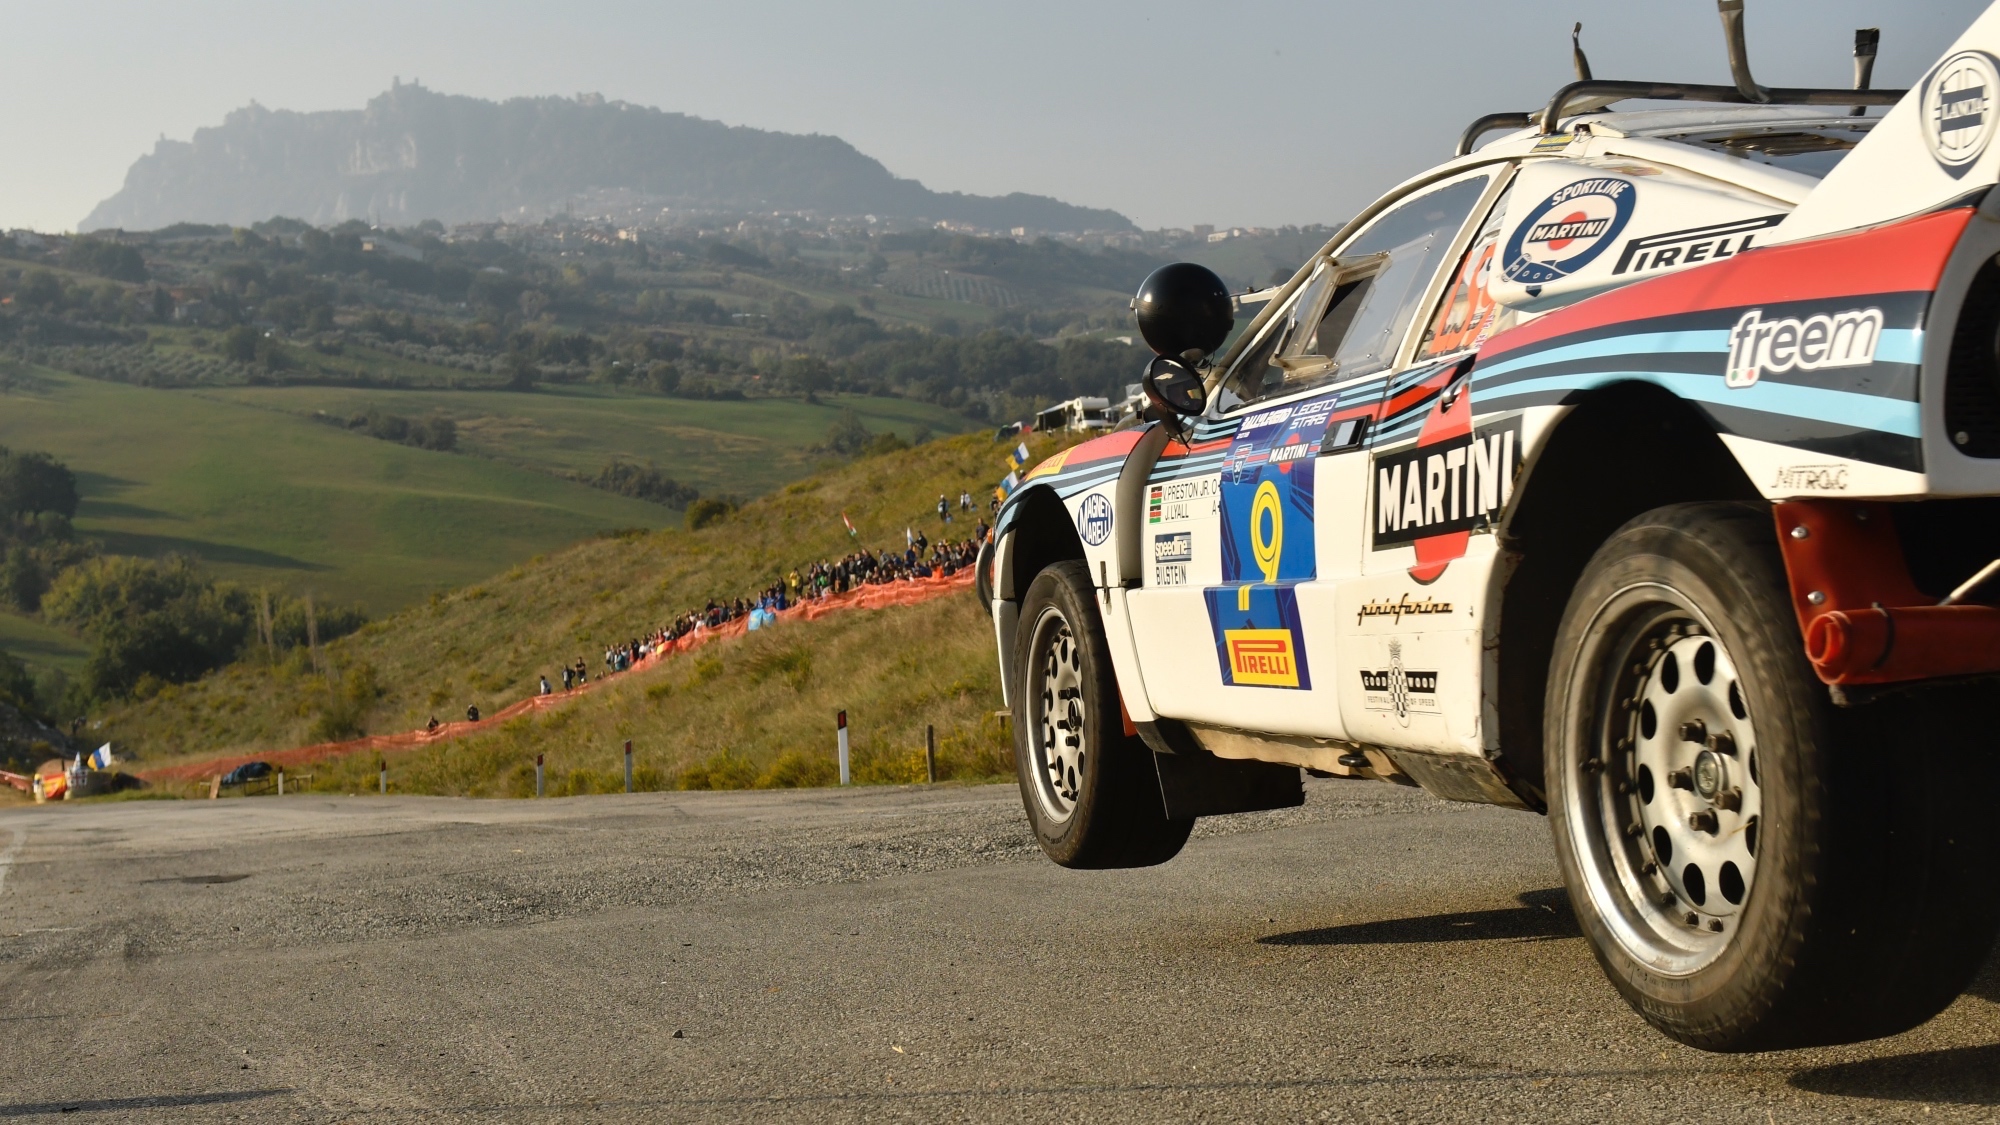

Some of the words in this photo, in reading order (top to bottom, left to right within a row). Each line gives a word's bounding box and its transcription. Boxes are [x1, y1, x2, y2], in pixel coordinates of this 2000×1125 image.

[1551, 180, 1630, 206] SPORTLINE
[1530, 221, 1606, 241] MARTINI
[1612, 213, 1790, 276] PIRELL
[1730, 310, 1880, 373] freem
[1290, 398, 1338, 418] LEGEND
[1289, 412, 1330, 430] STARS
[1268, 443, 1310, 463] MARTINI
[1378, 430, 1514, 534] MARTINI
[1080, 495, 1112, 519] MAGNETI
[1080, 519, 1112, 545] MARELLI
[1155, 535, 1188, 557] speedline
[1238, 480, 1284, 610] 9
[1156, 564, 1187, 586] BILSTEIN
[1357, 592, 1453, 626] pininfarina
[1232, 640, 1290, 675] PIRELLI
[1364, 676, 1387, 687] GOOD
